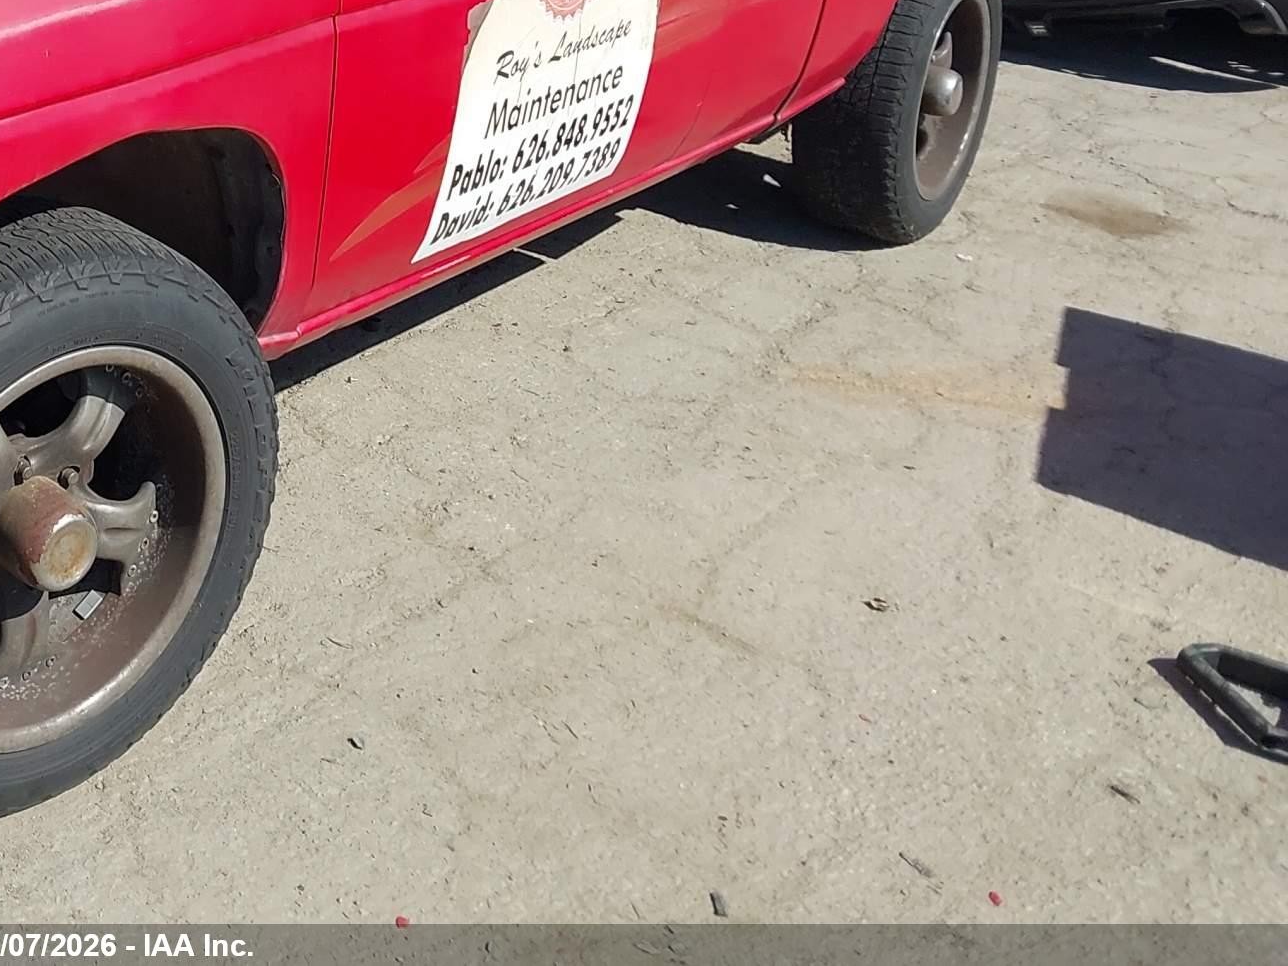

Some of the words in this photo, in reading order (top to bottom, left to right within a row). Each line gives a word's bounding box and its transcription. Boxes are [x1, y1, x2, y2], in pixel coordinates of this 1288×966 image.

[493, 41, 542, 85] Roy's
[547, 19, 632, 64] Landscape
[447, 149, 508, 201] Pablo:
[511, 94, 635, 174] 626.848.9552
[483, 65, 623, 140] Maintenance
[429, 191, 495, 246] David:
[495, 137, 622, 217] 626.209.7389
